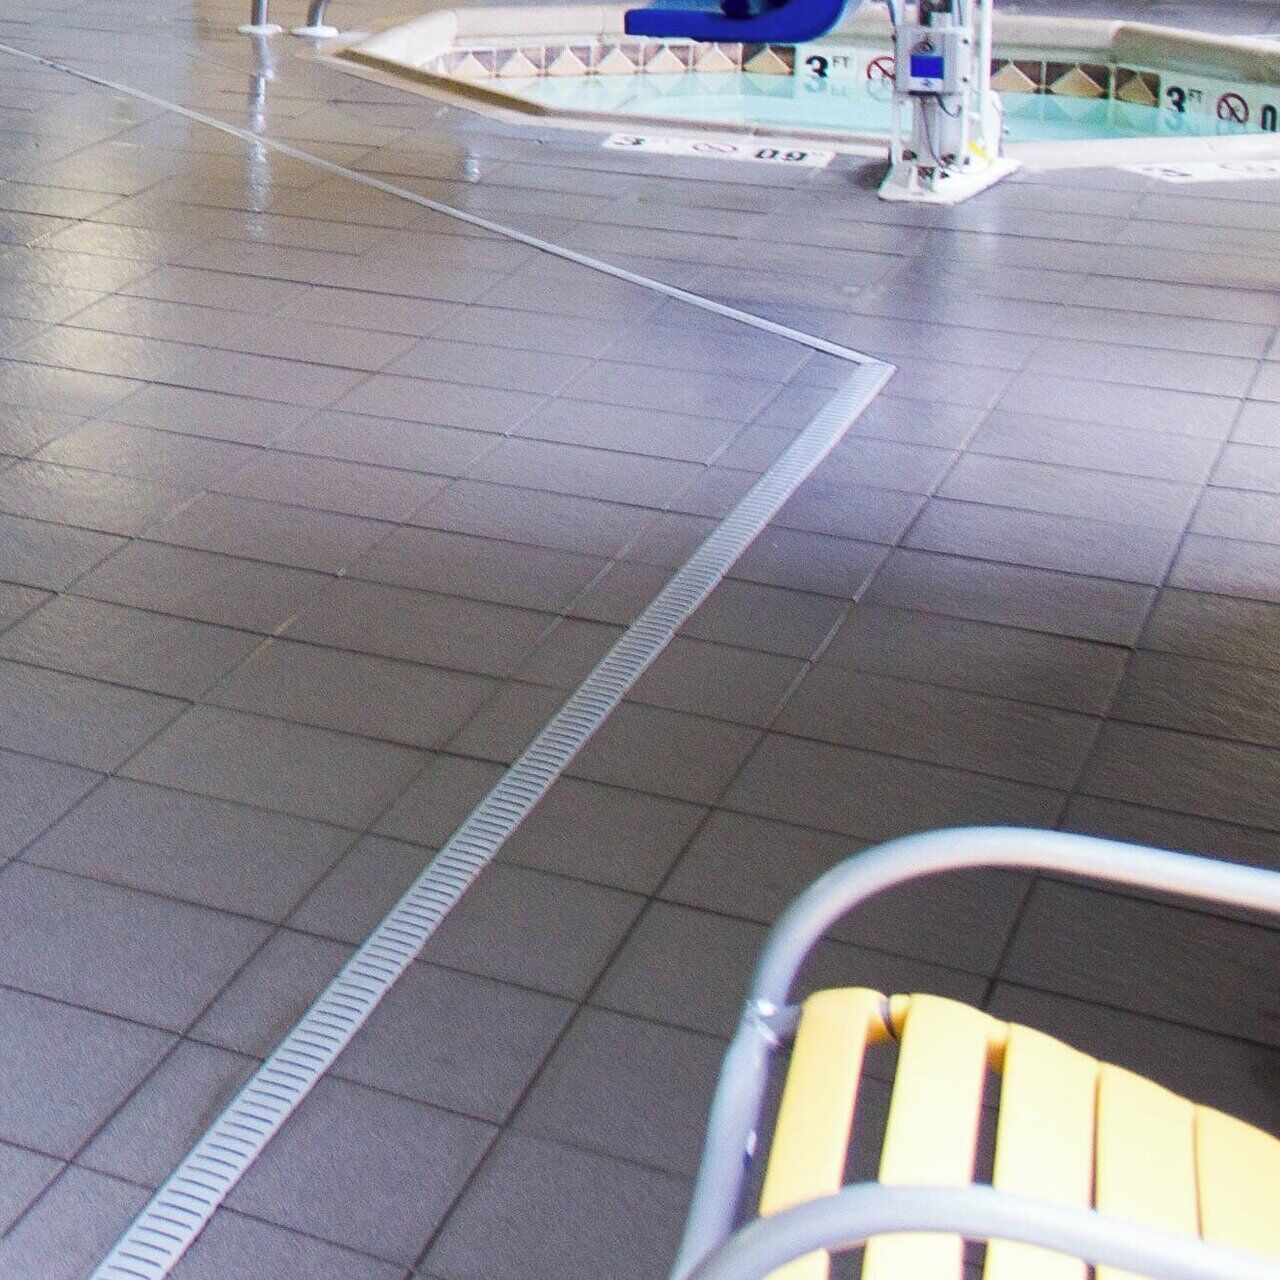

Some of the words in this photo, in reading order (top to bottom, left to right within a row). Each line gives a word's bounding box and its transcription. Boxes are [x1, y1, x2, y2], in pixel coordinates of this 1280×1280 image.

[805, 55, 829, 79] 3
[832, 56, 850, 68] FT
[1166, 85, 1186, 113] 3
